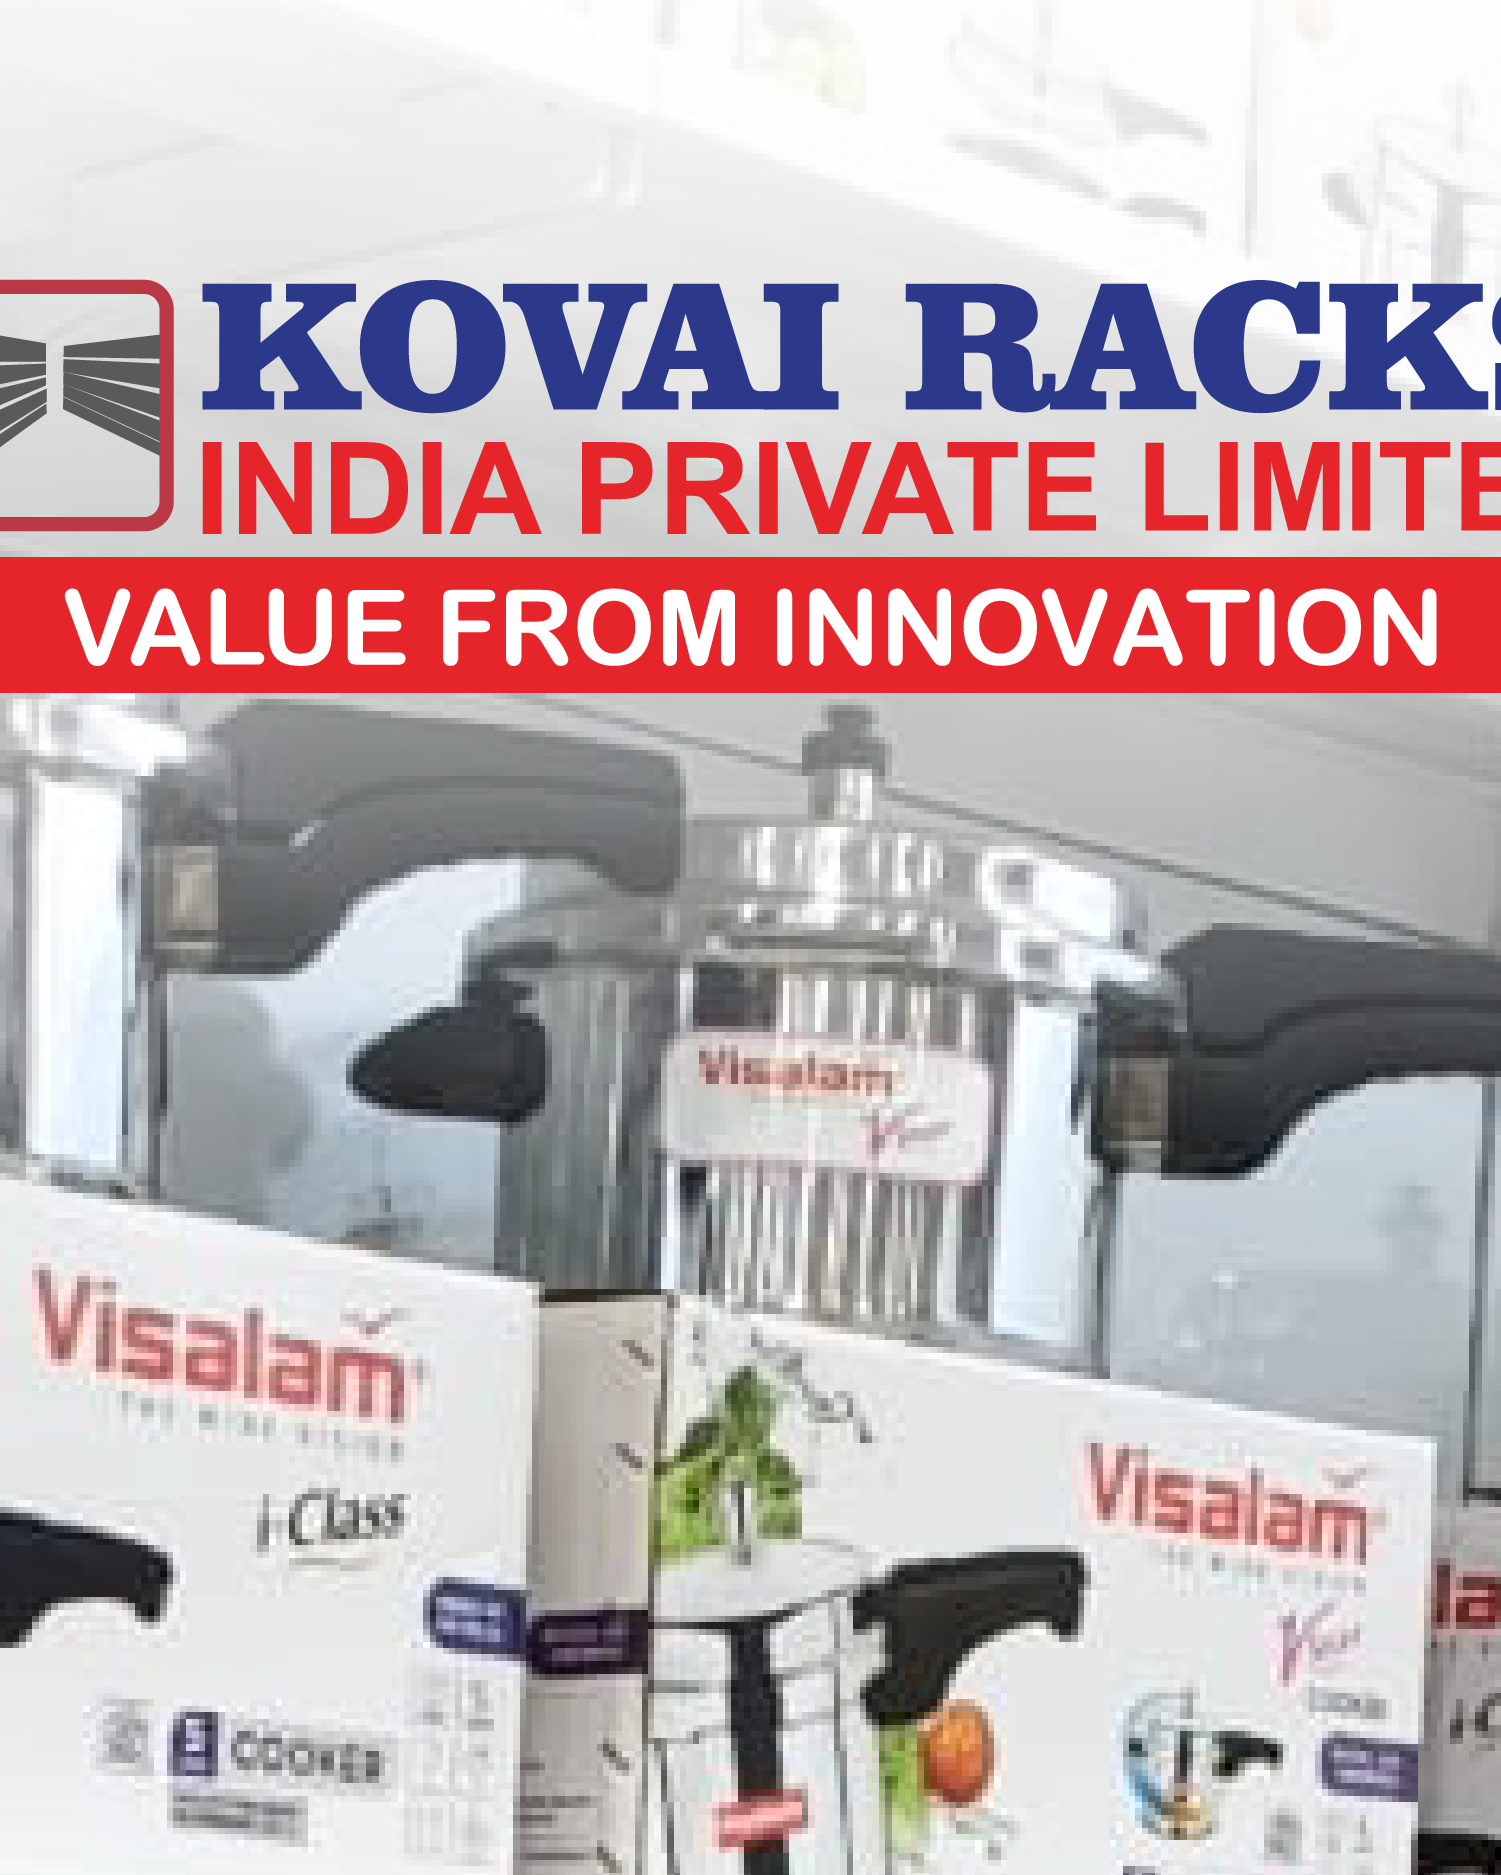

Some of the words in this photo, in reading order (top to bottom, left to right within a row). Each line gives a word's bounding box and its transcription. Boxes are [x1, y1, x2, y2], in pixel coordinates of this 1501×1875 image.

[698, 1043, 897, 1097] Visalam
[35, 1266, 406, 1426] Visalam
[1086, 1440, 1368, 1570] Visalam
[230, 1724, 384, 1785] COOKER
